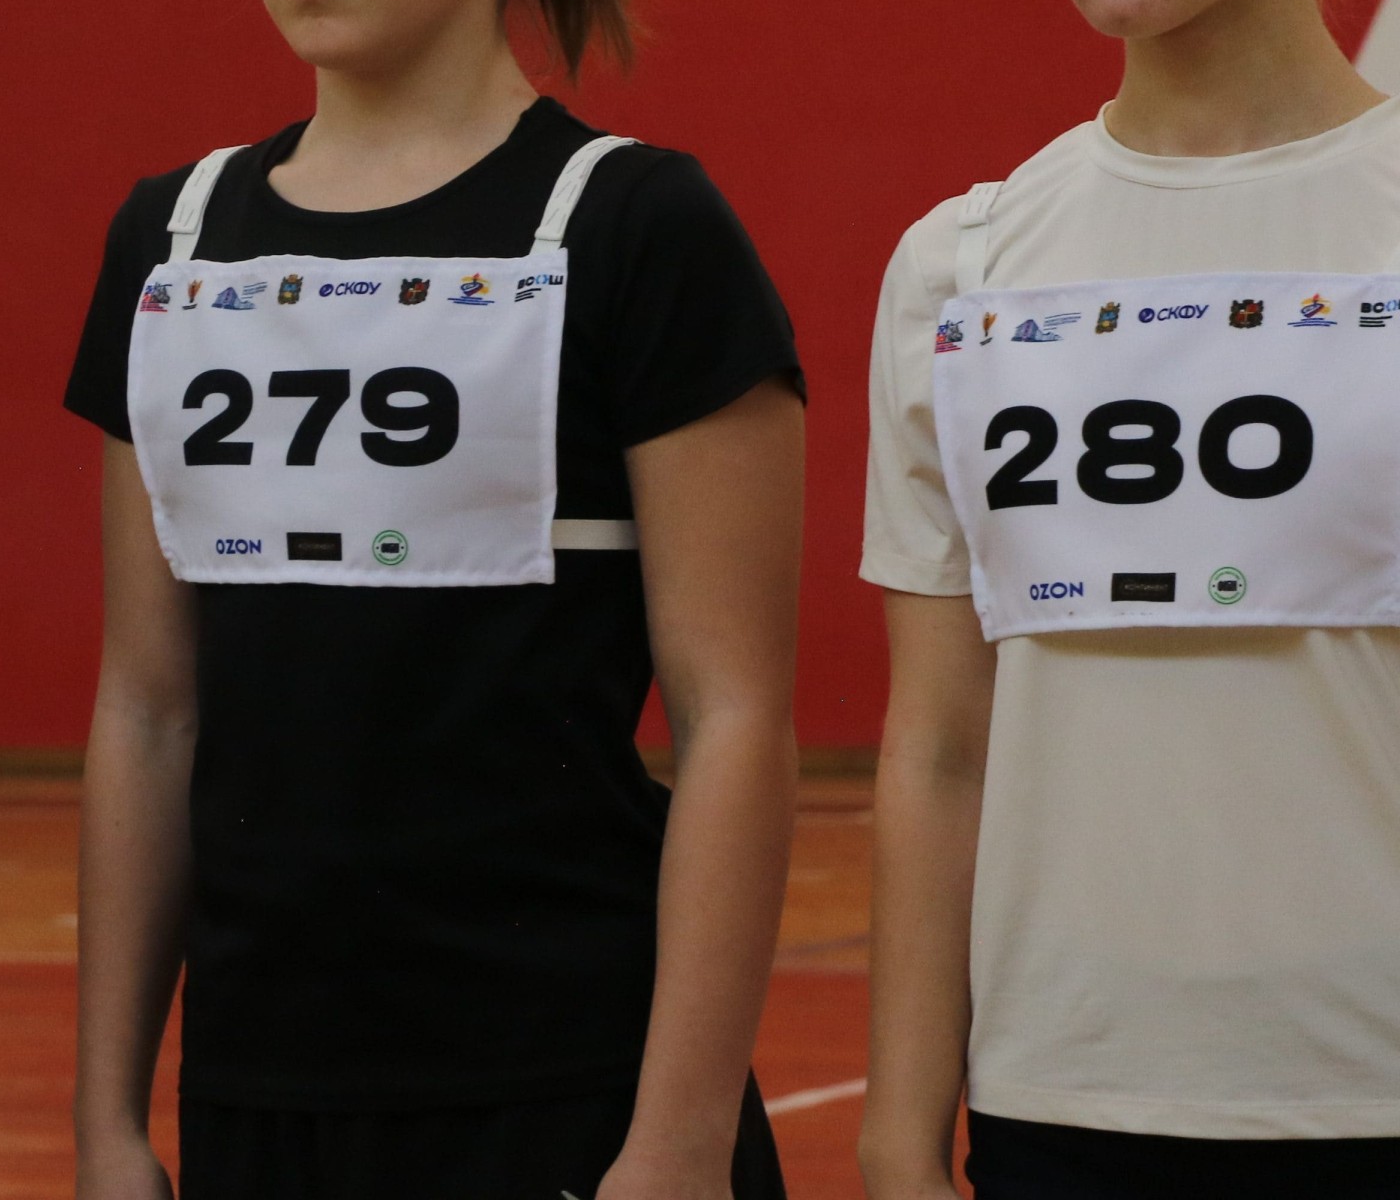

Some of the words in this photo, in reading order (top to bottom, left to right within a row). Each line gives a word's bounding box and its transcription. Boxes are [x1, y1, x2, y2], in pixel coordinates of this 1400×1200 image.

[335, 282, 381, 296] СКФУ
[1157, 305, 1209, 321] СКФУ
[182, 366, 460, 467] 279
[983, 394, 1314, 511] 280
[216, 538, 262, 555] OZON
[1030, 581, 1084, 601] OZON
